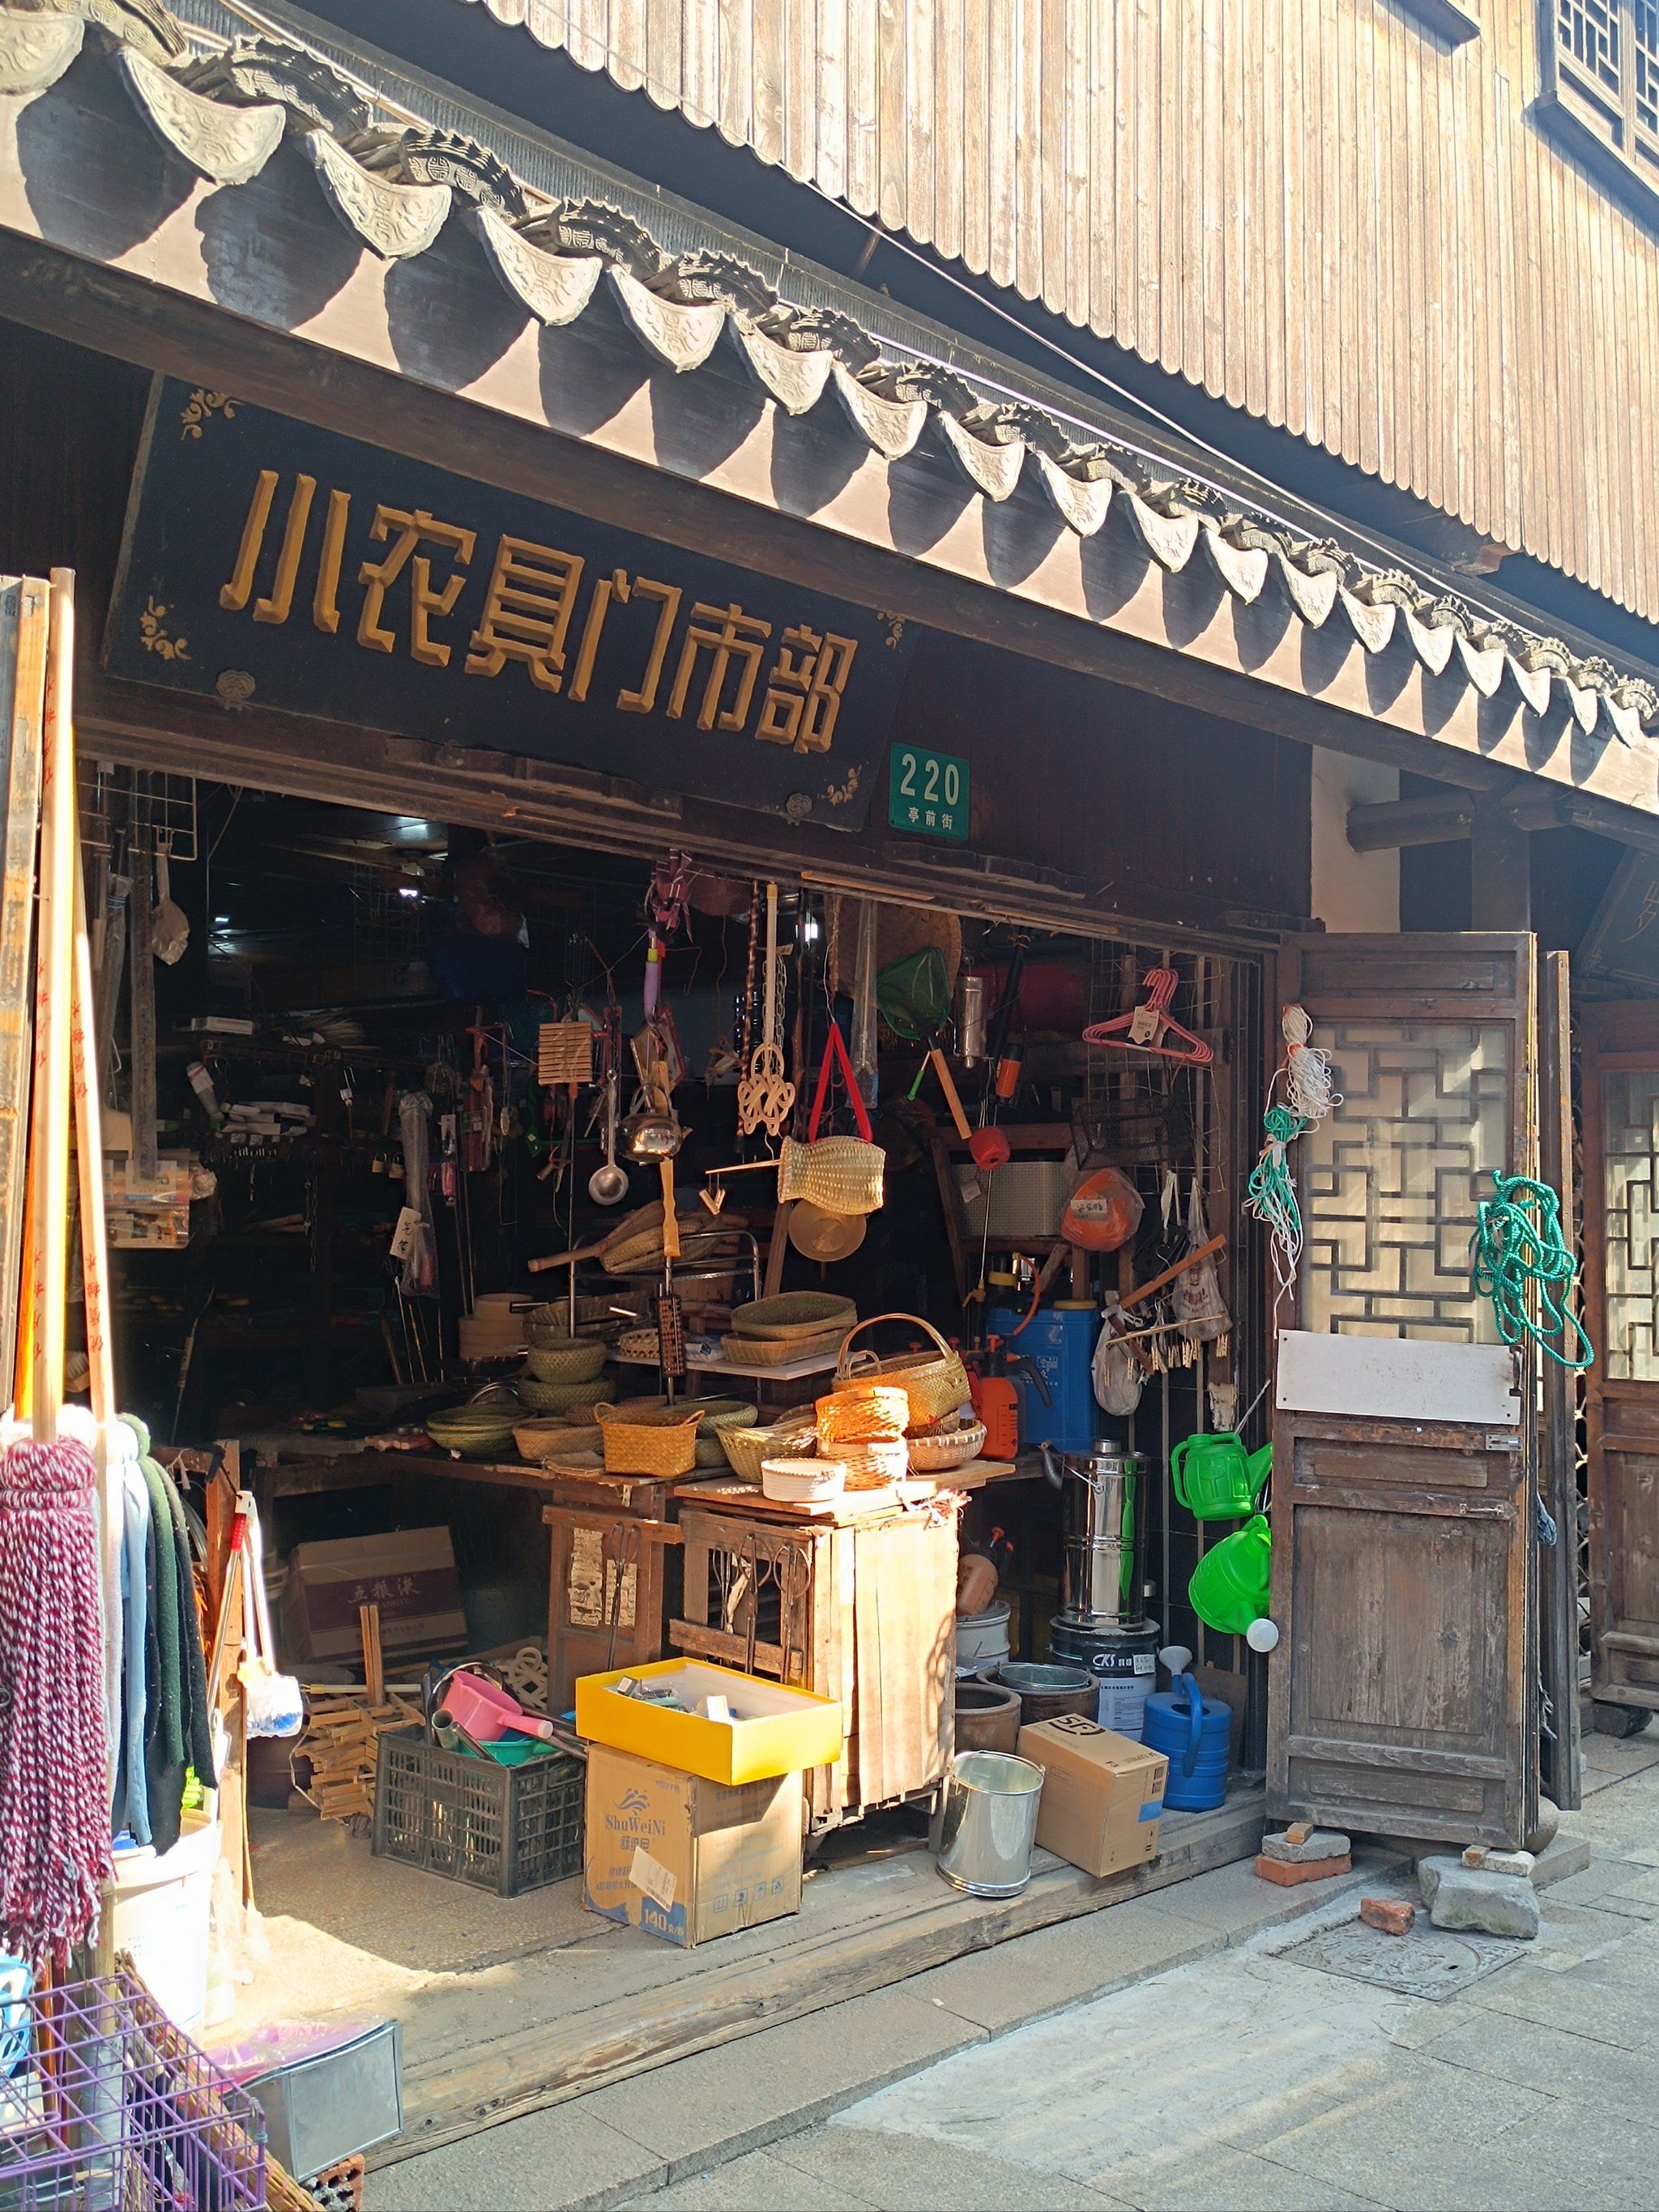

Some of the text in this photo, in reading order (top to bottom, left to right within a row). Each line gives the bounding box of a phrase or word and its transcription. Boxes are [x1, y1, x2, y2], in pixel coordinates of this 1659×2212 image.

[220, 469, 858, 754] 小农具门市部
[900, 752, 959, 805] 220
[908, 807, 953, 830] 亭前街
[346, 1575, 420, 1604] 五粮液
[1092, 1653, 1116, 1668] CKS
[1056, 1716, 1097, 1729] SF
[605, 1814, 666, 1836] ShuWeiNi
